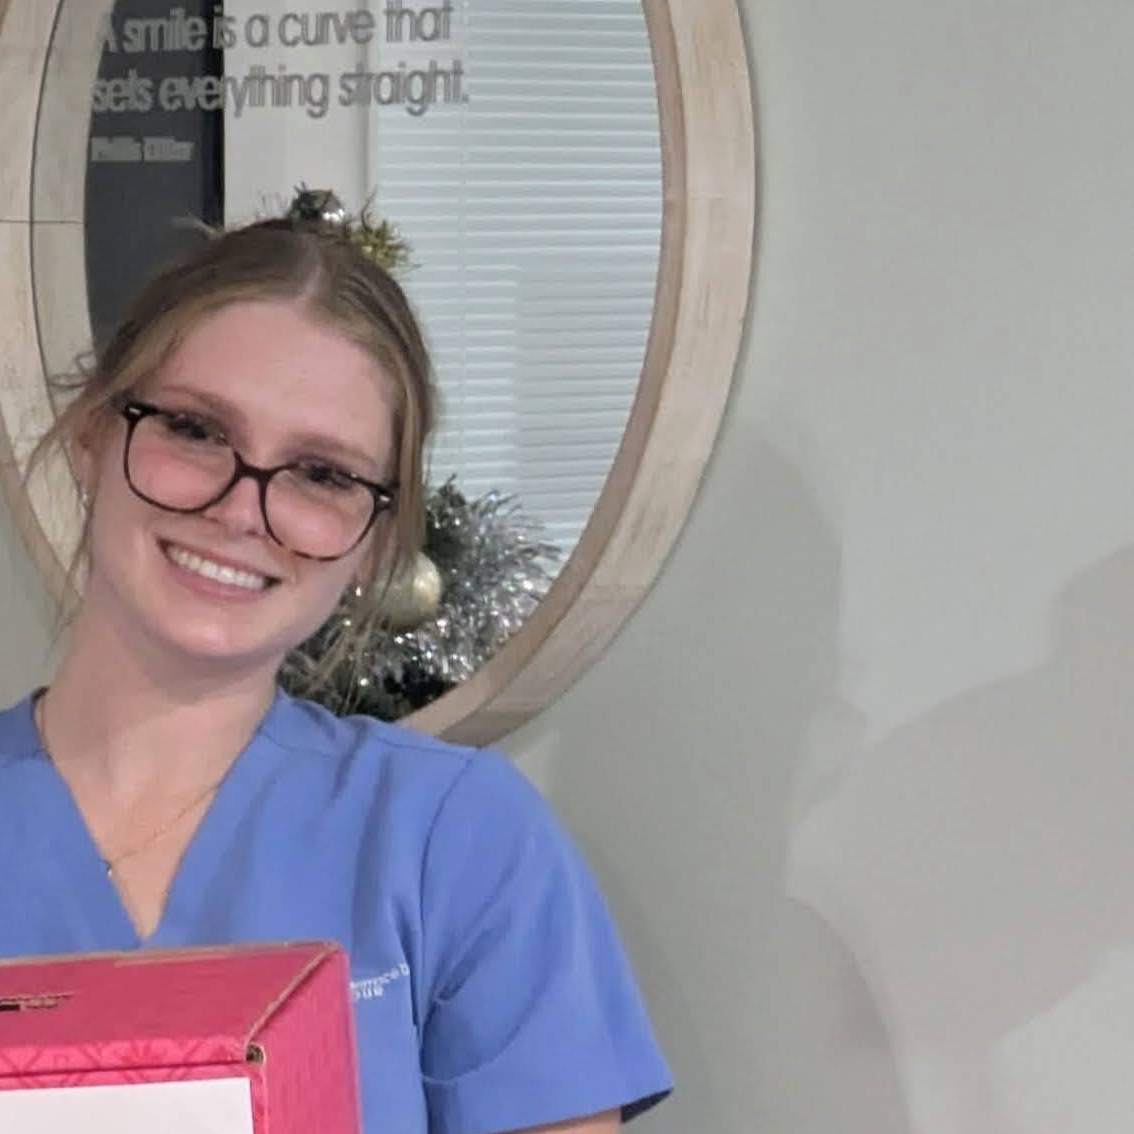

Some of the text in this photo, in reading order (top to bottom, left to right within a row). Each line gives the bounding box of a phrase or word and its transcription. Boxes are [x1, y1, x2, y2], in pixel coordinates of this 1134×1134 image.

[123, 7, 208, 52] smile
[213, 4, 237, 49] is
[245, 13, 270, 48] a
[278, 9, 375, 47] curve
[383, 0, 454, 43] that
[92, 59, 470, 118] sets everything straight.
